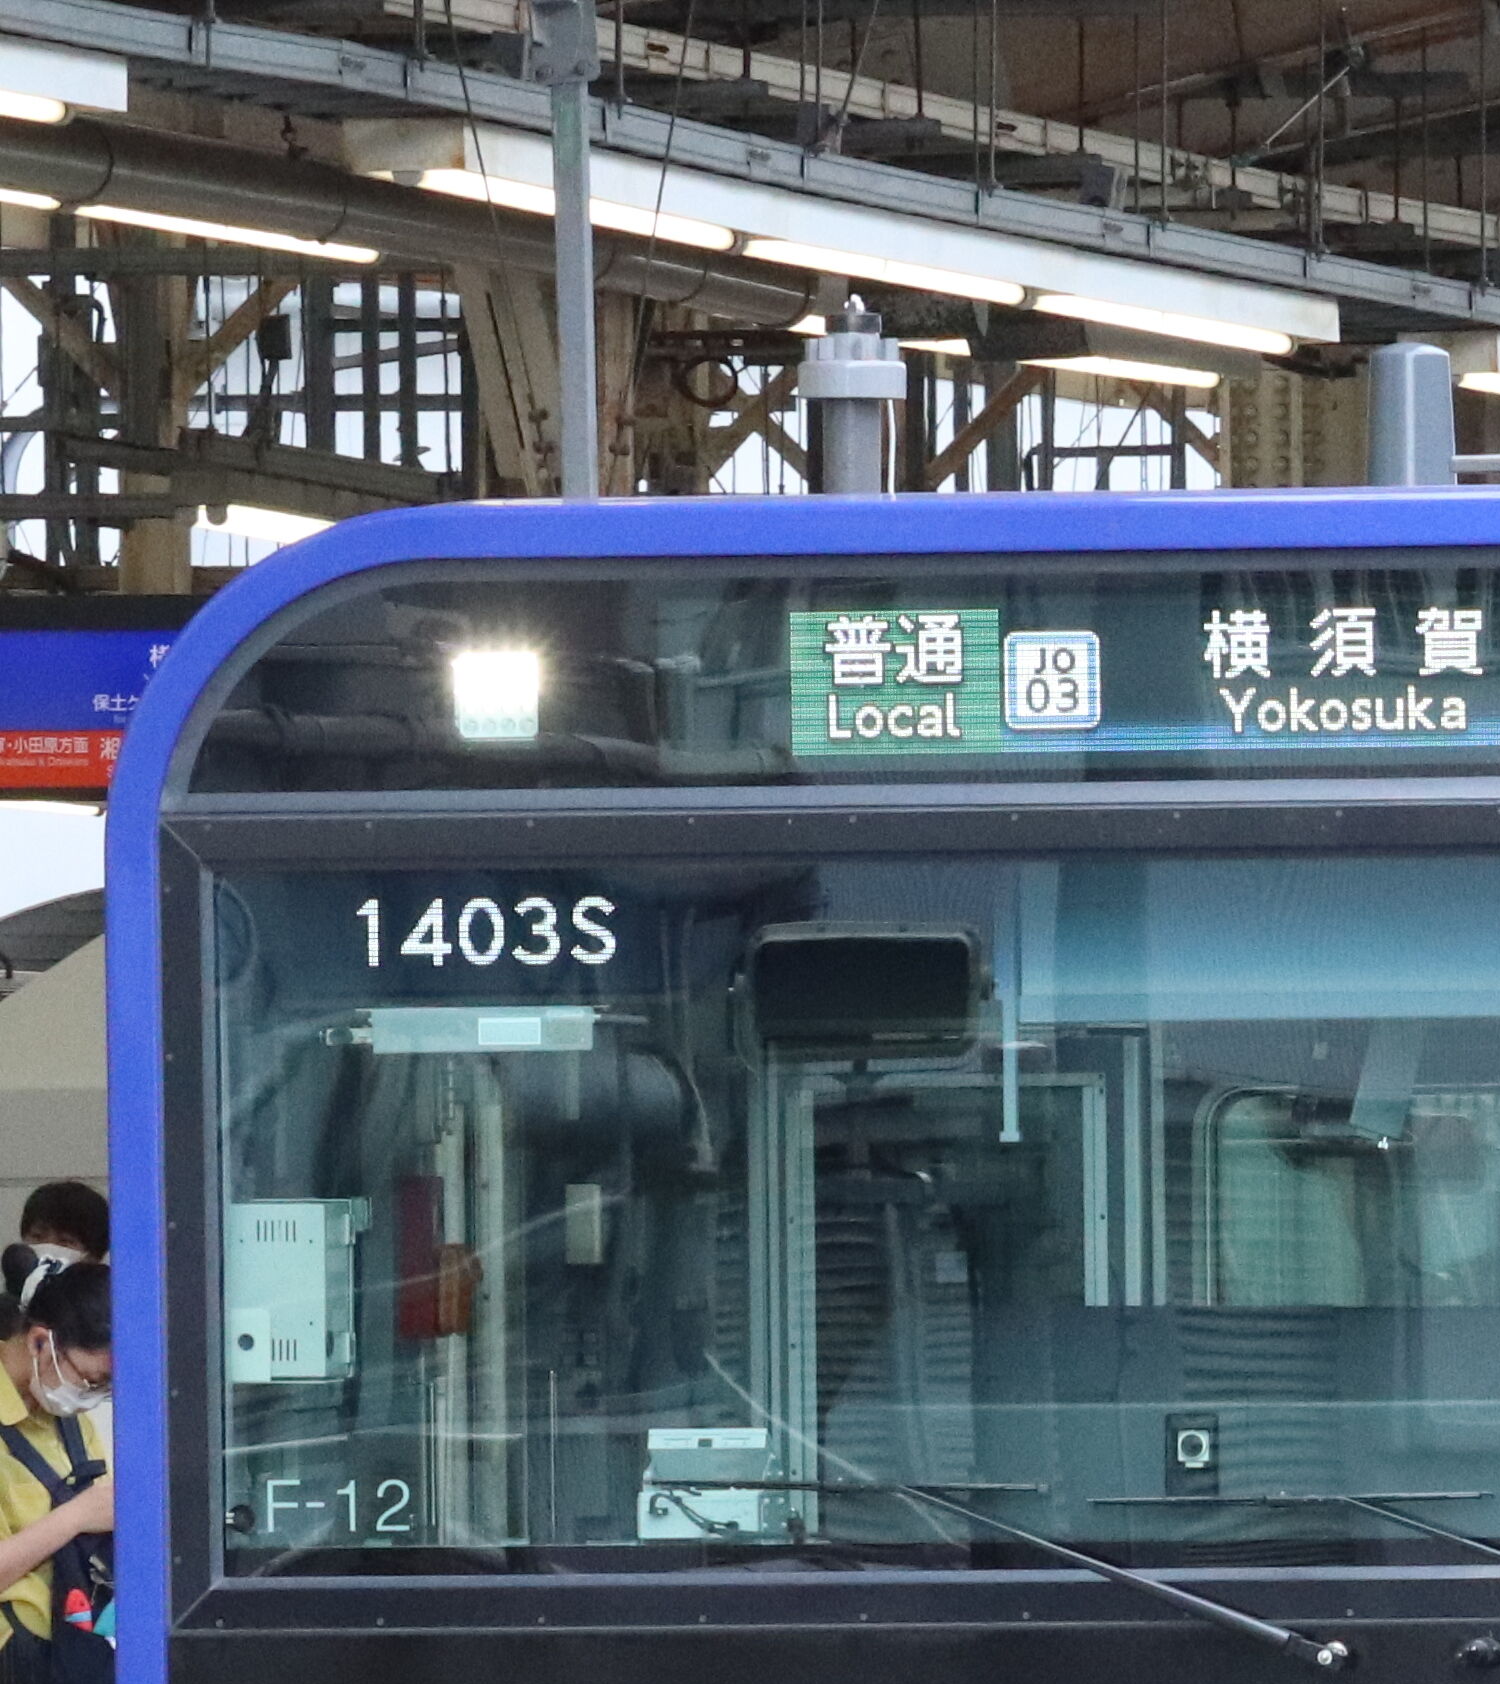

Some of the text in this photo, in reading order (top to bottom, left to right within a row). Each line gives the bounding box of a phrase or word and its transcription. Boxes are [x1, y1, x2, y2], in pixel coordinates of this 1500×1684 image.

[824, 607, 1483, 686] 普通 横須賀
[1034, 647, 1077, 676] JO
[827, 685, 1468, 739] Local Yokosuka
[1025, 677, 1080, 713] 03
[355, 895, 617, 968] 1403S
[266, 1478, 412, 1533] F-12
